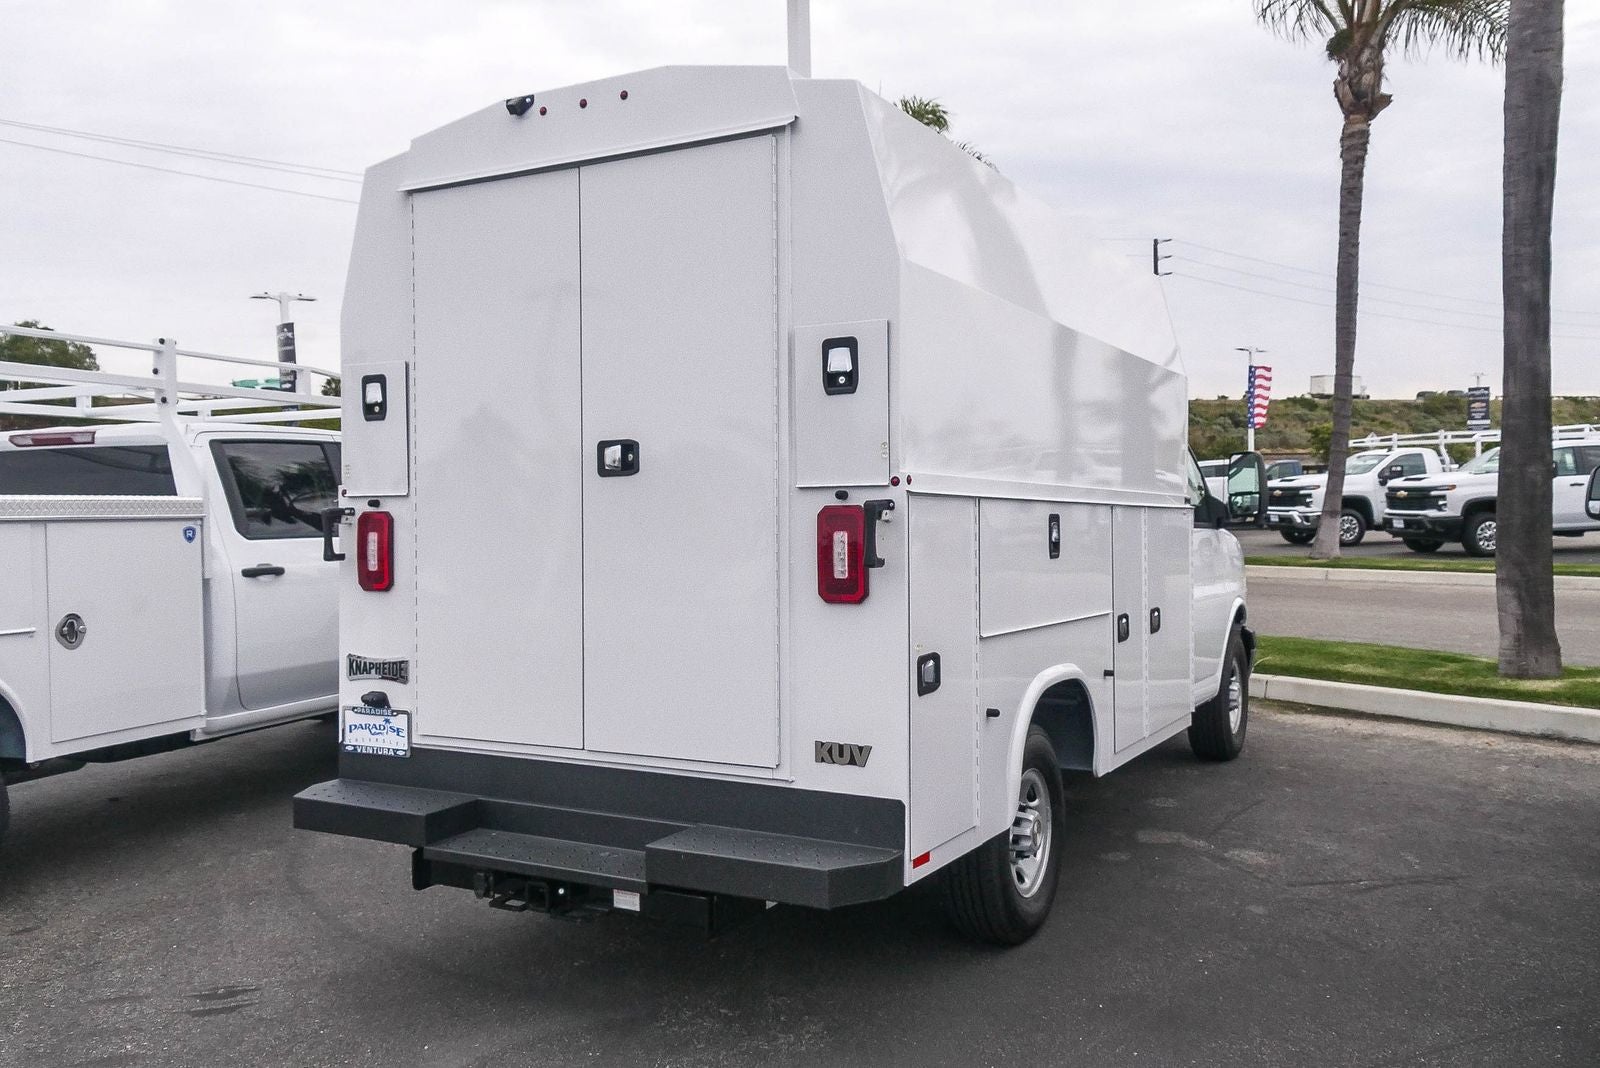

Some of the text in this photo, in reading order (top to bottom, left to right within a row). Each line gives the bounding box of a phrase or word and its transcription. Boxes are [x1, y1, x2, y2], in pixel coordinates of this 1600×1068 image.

[348, 657, 408, 680] KNAPHEIDE
[357, 707, 392, 716] PARADISE
[349, 719, 405, 738] PARADISE
[356, 745, 395, 756] VENTURA
[815, 740, 872, 767] KUV
